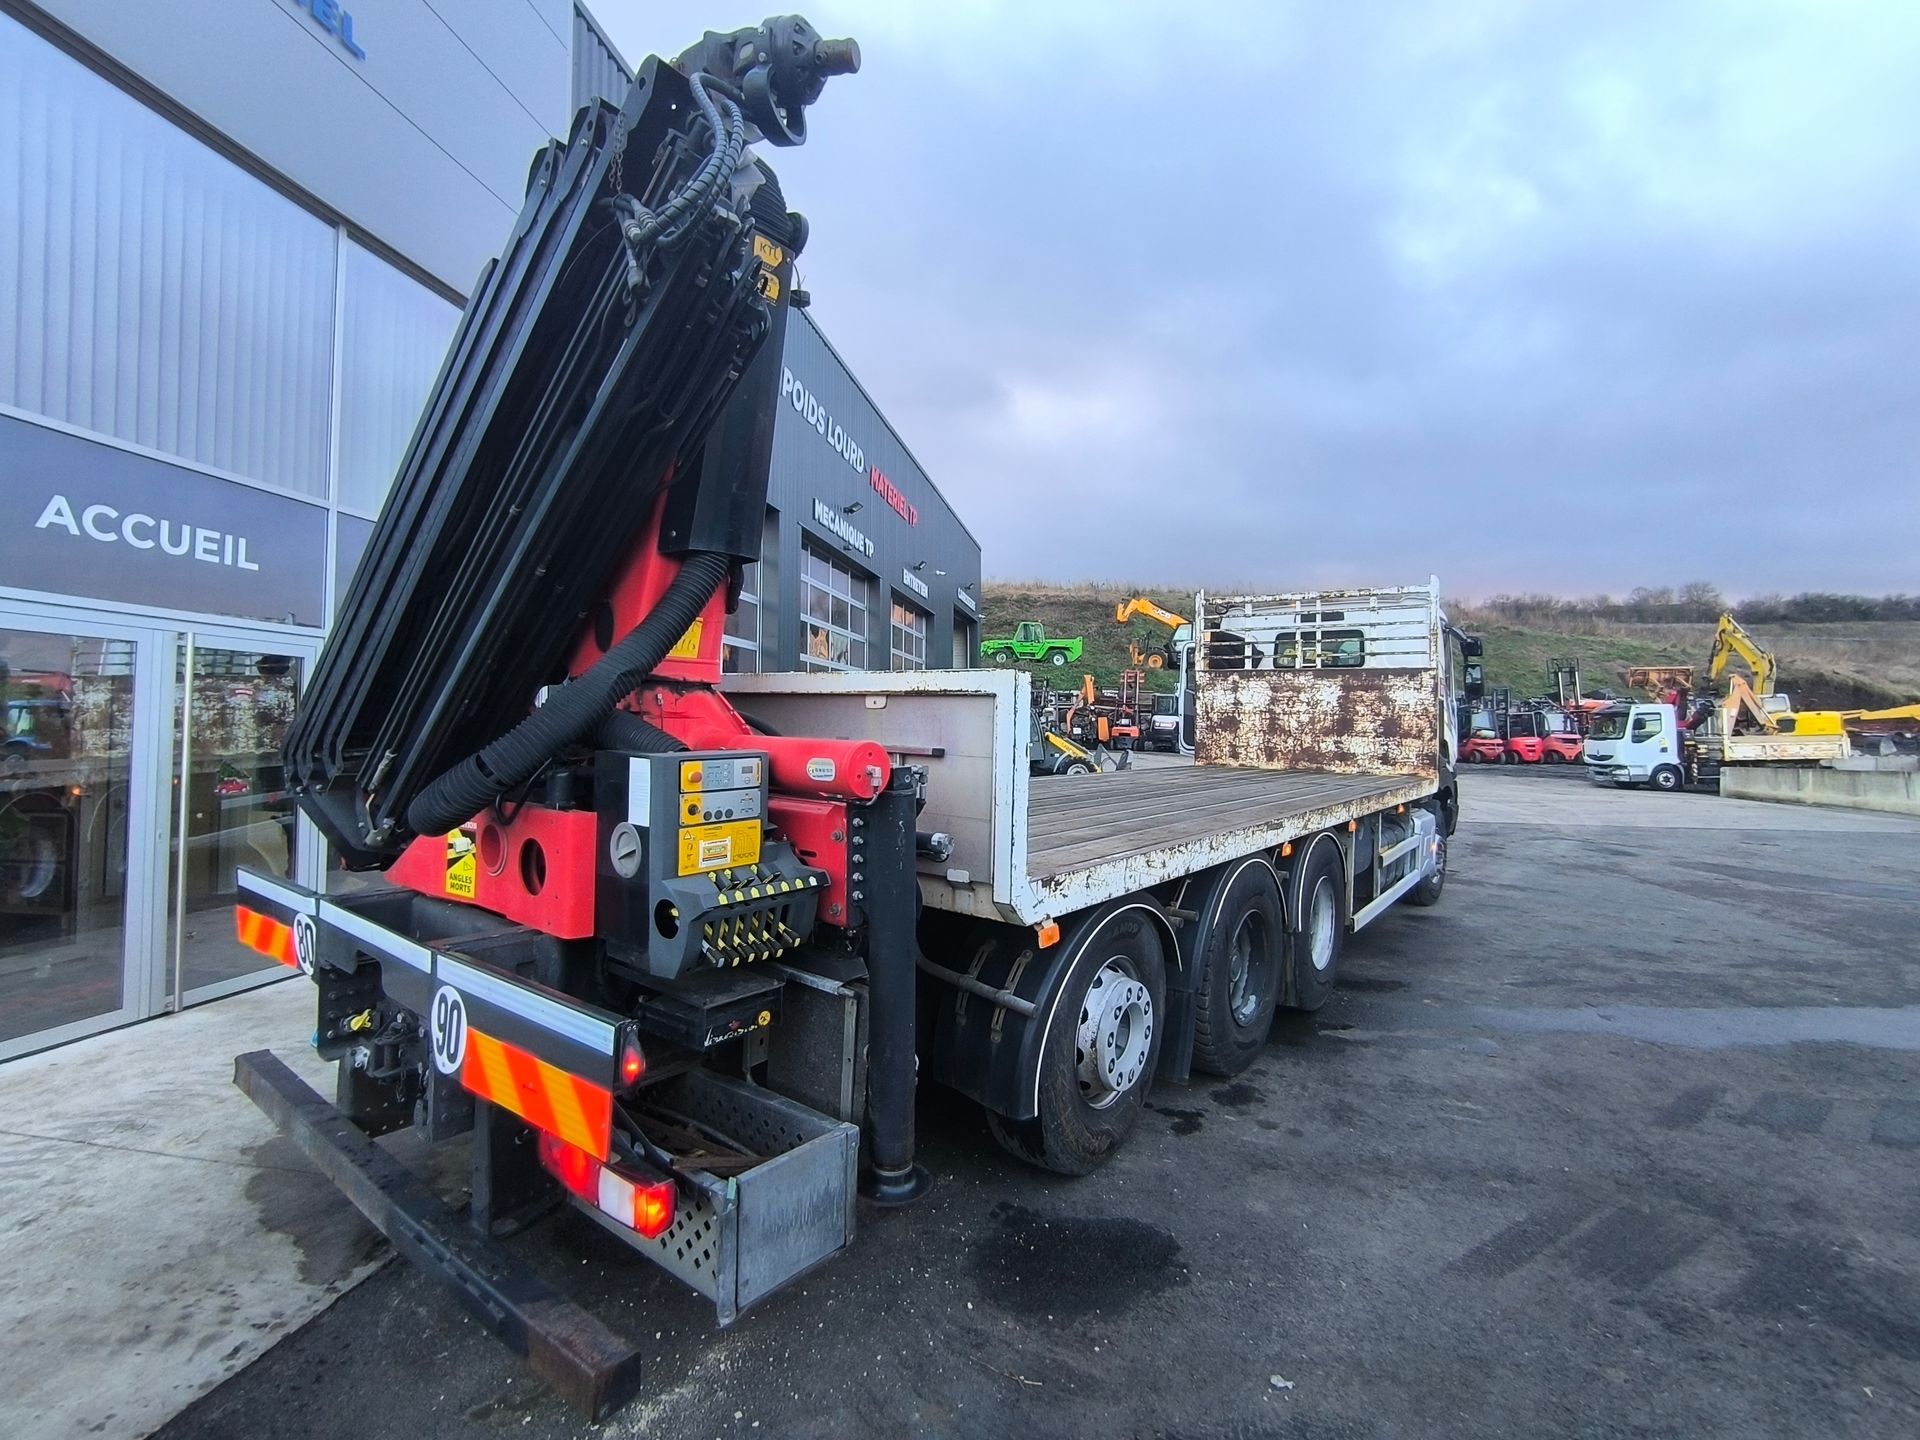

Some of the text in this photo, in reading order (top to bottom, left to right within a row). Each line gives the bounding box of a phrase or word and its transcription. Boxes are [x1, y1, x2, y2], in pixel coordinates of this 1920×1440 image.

[295, 0, 366, 61] EL
[781, 366, 865, 474] POIDS LOURD
[870, 463, 919, 528] MATERIEL TP
[34, 494, 259, 571] ACCUEIL
[814, 497, 875, 558] MECANIQUE TP
[1155, 608, 1173, 619] JCB
[449, 872, 473, 885] ANGLES
[450, 881, 471, 894] MORTS
[297, 918, 314, 969] 80
[436, 992, 462, 1065] 90
